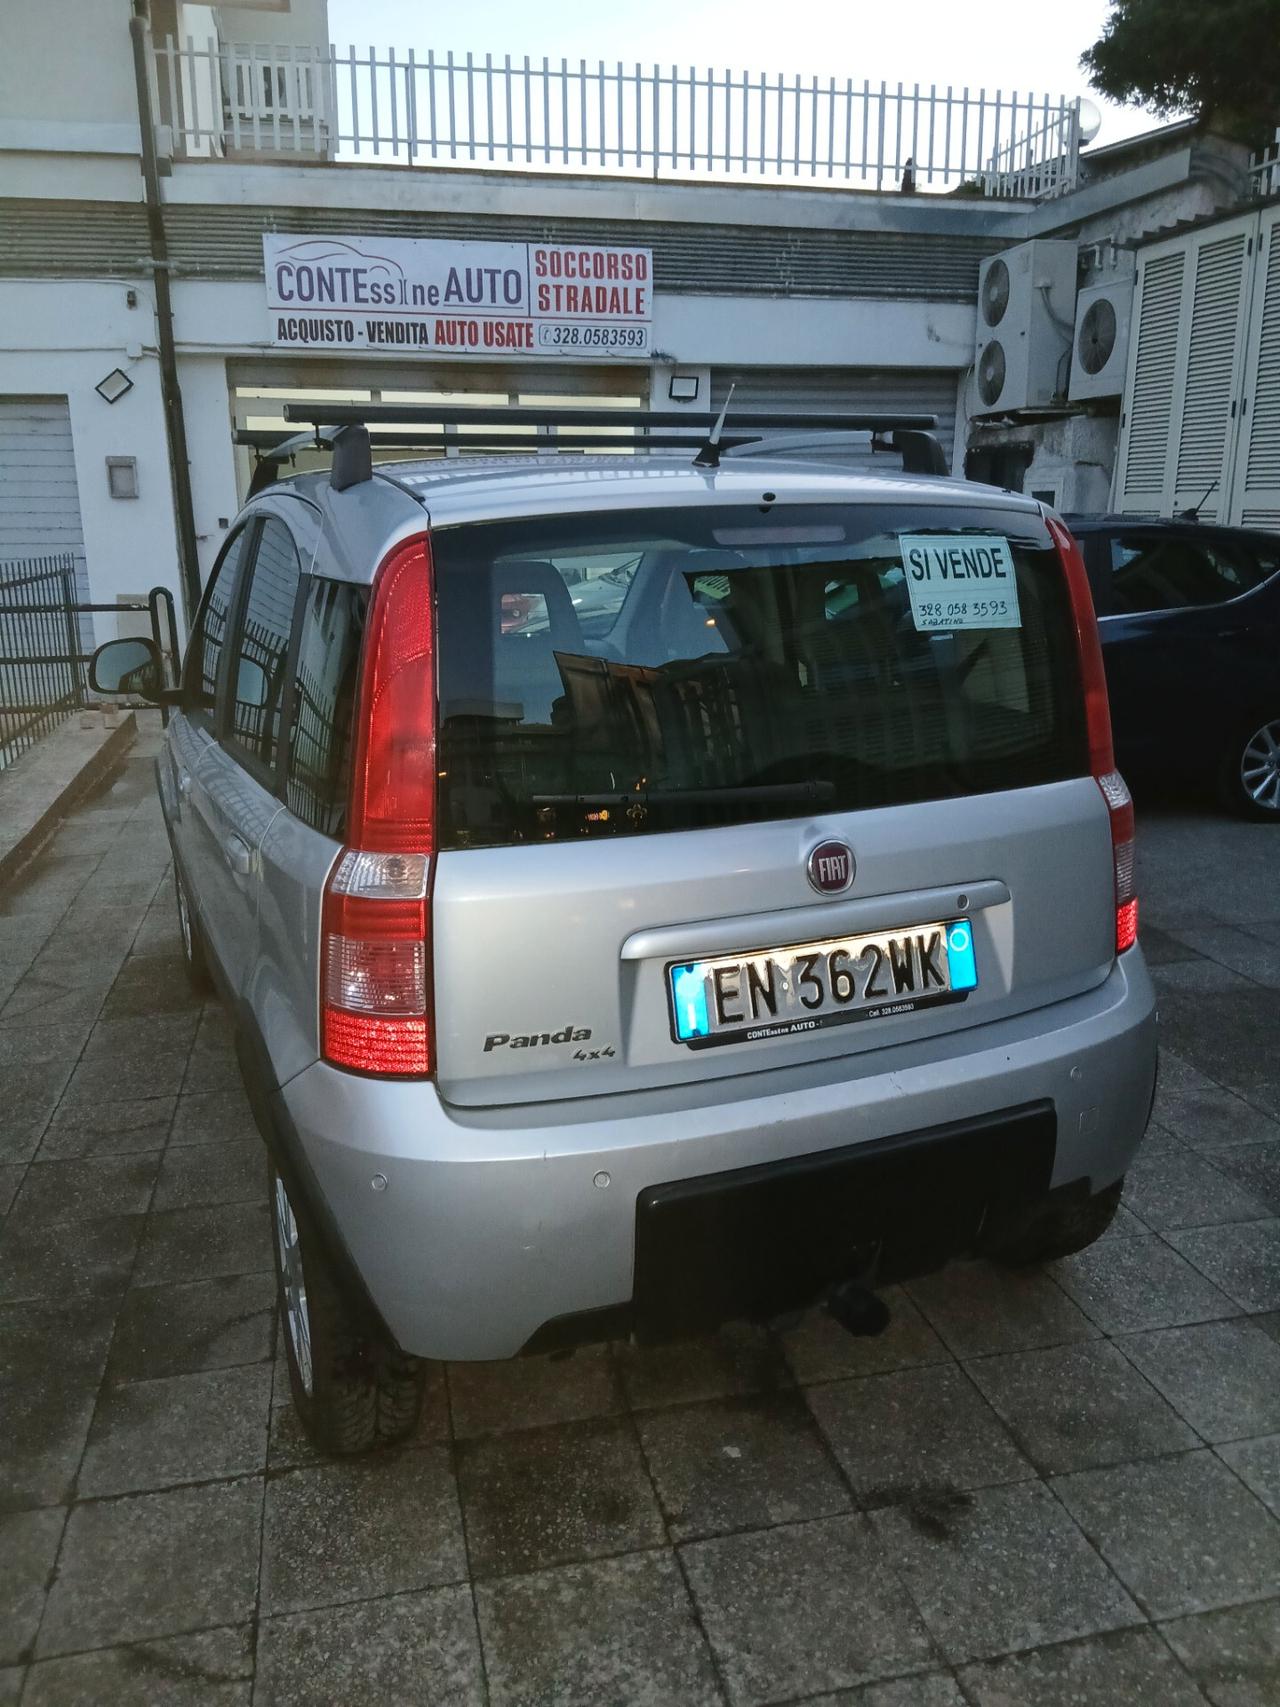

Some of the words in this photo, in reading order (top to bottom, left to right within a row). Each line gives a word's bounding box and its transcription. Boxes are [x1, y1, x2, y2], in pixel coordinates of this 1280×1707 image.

[534, 249, 648, 281] SOCCORSO
[443, 267, 522, 305] AUTO
[537, 283, 646, 315] STRADALE
[277, 317, 355, 344] ACQUISTO
[365, 320, 429, 345] VENDITA
[434, 319, 480, 347] AUTO
[482, 321, 535, 348] USATE
[552, 326, 645, 347] 328.0583593
[909, 548, 931, 581] SI
[933, 547, 1007, 580] VENDE
[918, 602, 943, 617] 328
[947, 602, 968, 617] 058
[972, 600, 1009, 617] 3593
[818, 854, 846, 883] FIAT
[483, 1025, 592, 1052] Panda
[790, 1020, 816, 1032] AUTO
[572, 1046, 616, 1061] 4x4
